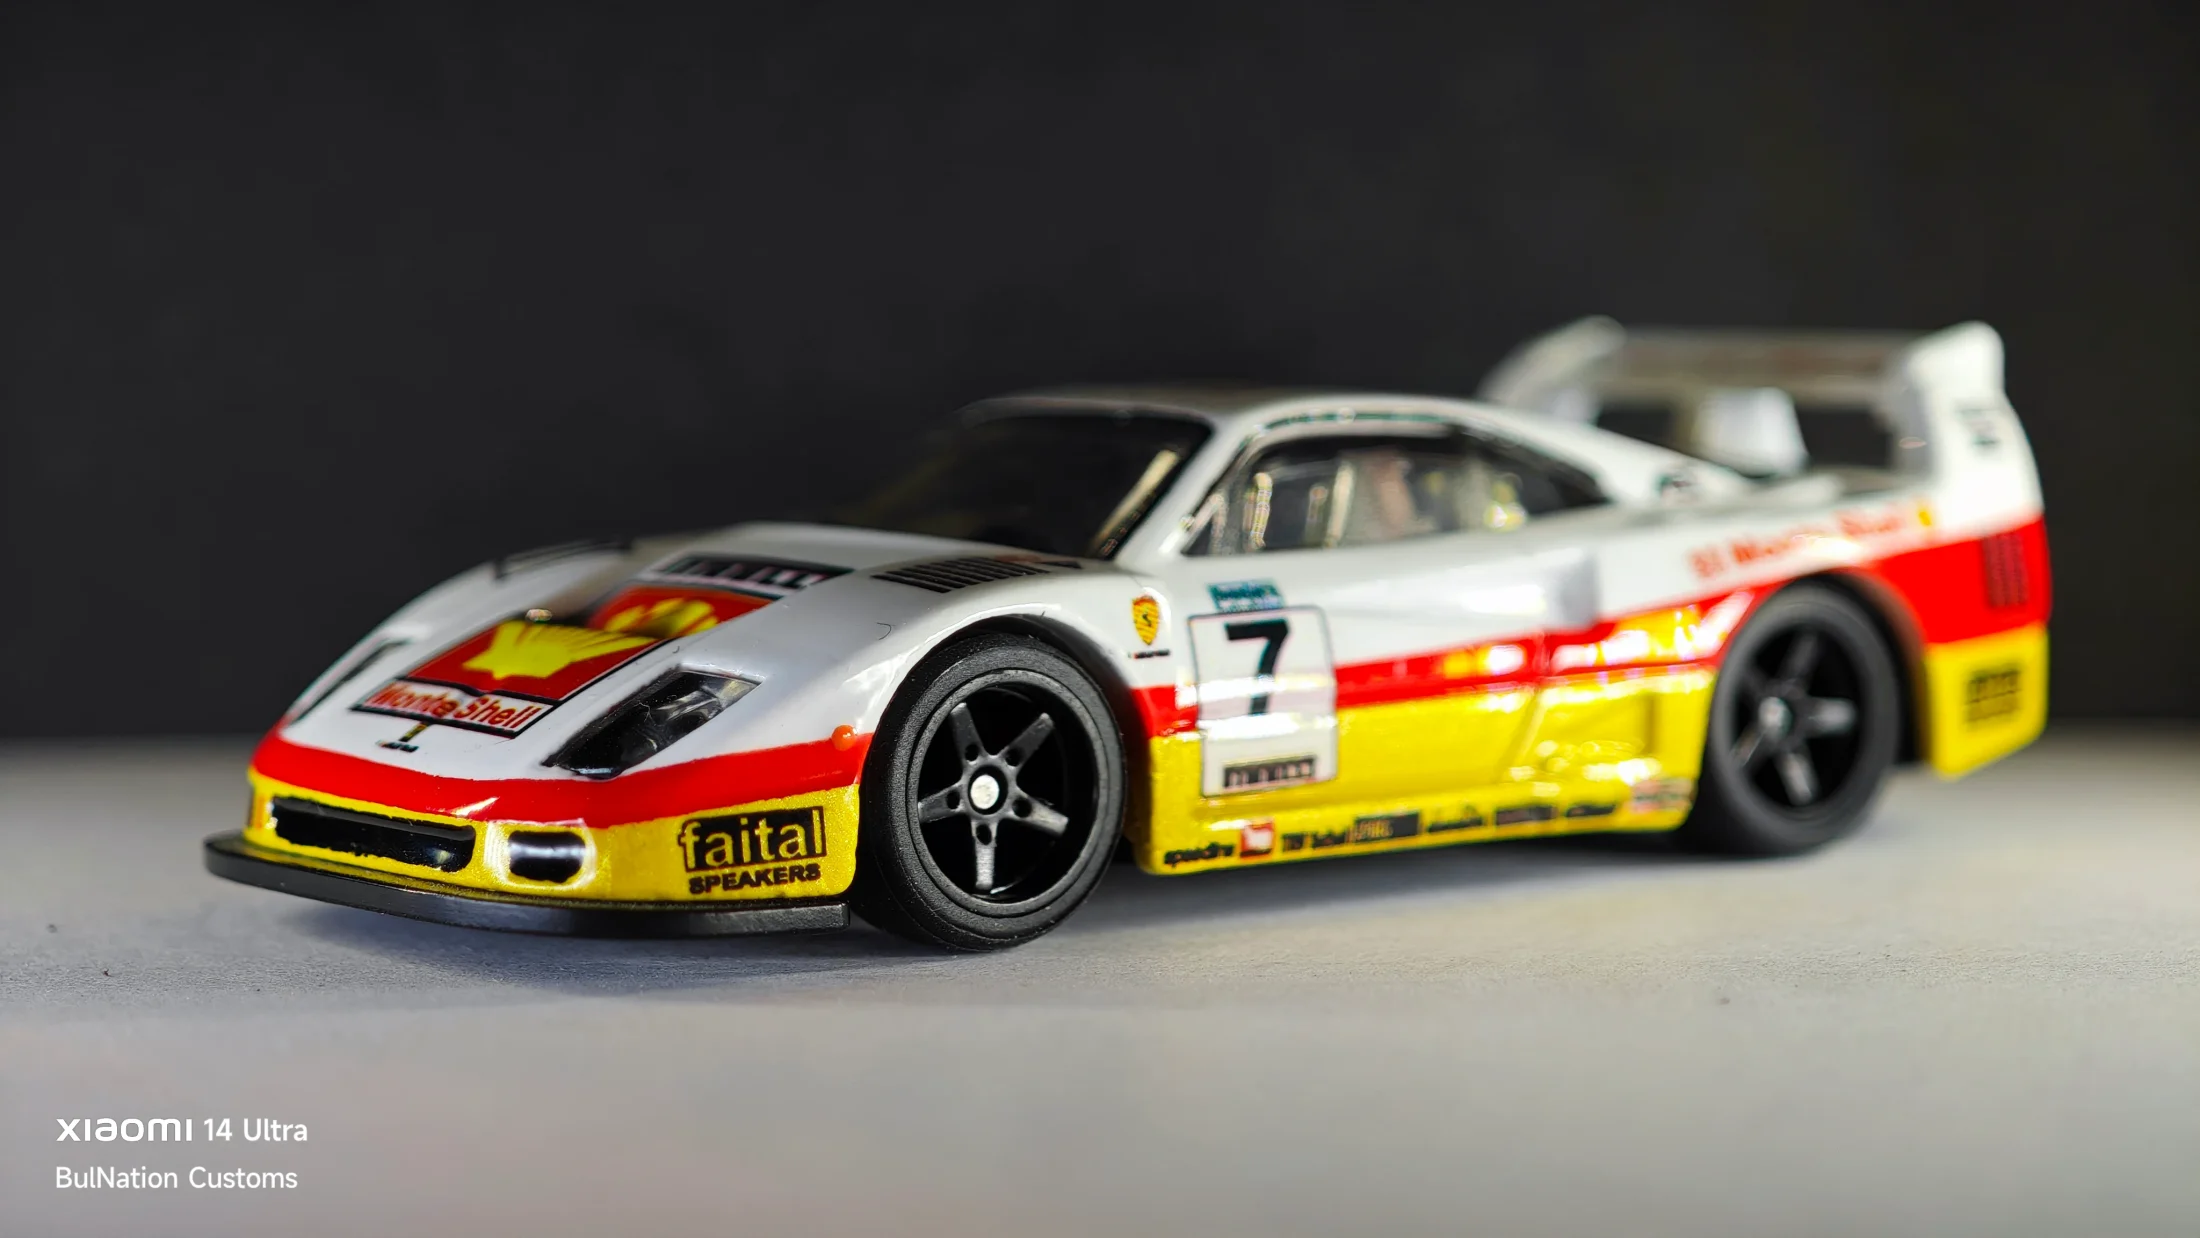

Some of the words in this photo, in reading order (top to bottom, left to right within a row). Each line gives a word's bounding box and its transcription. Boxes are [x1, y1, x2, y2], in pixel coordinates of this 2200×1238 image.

[1224, 618, 1290, 716] 7
[453, 695, 543, 729] Shell
[680, 809, 823, 869] faital
[689, 863, 821, 894] SPEAKERS
